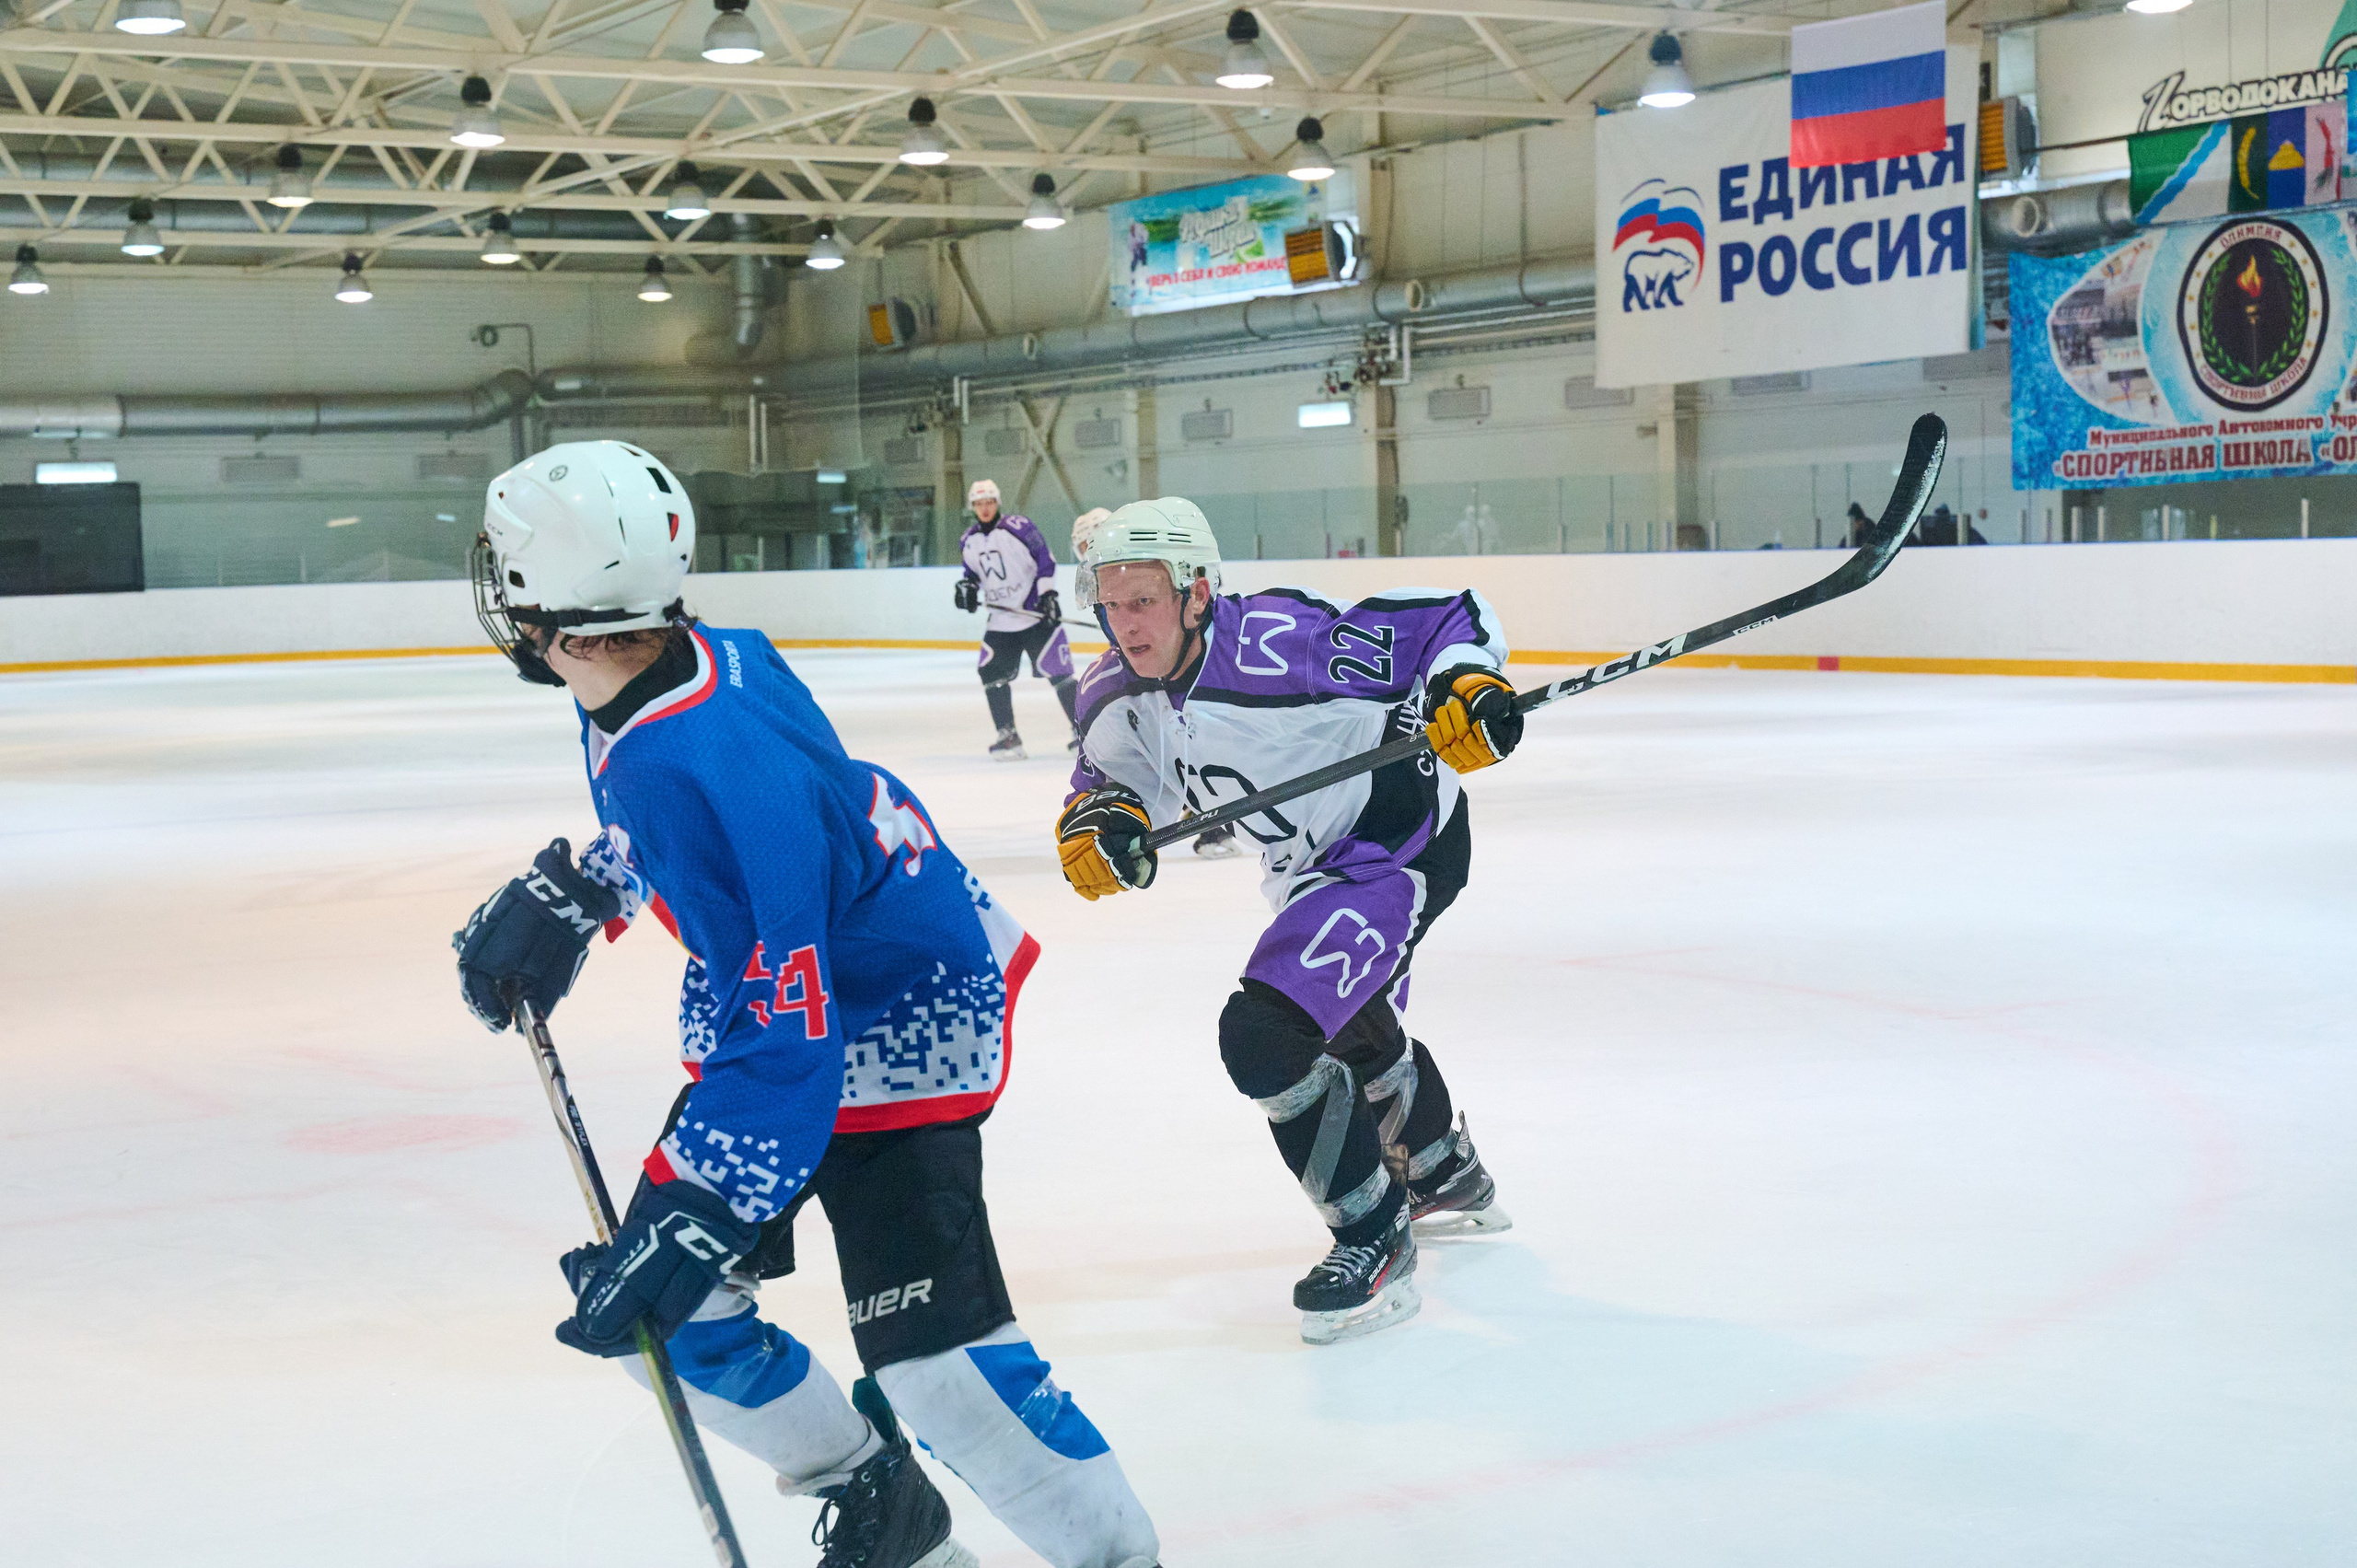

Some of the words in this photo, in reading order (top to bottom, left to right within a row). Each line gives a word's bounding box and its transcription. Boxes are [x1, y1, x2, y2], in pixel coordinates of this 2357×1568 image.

[1719, 123, 1966, 226] ЕДИНАЯ
[1719, 205, 1968, 303] РОССИЯ
[2219, 418, 2324, 436] Автономного
[2223, 438, 2312, 467] ШКОЛА
[1736, 616, 1775, 634] CCM
[1328, 621, 1395, 685] 22
[1547, 633, 1689, 700] CCM
[1367, 1253, 1389, 1284] BAUER
